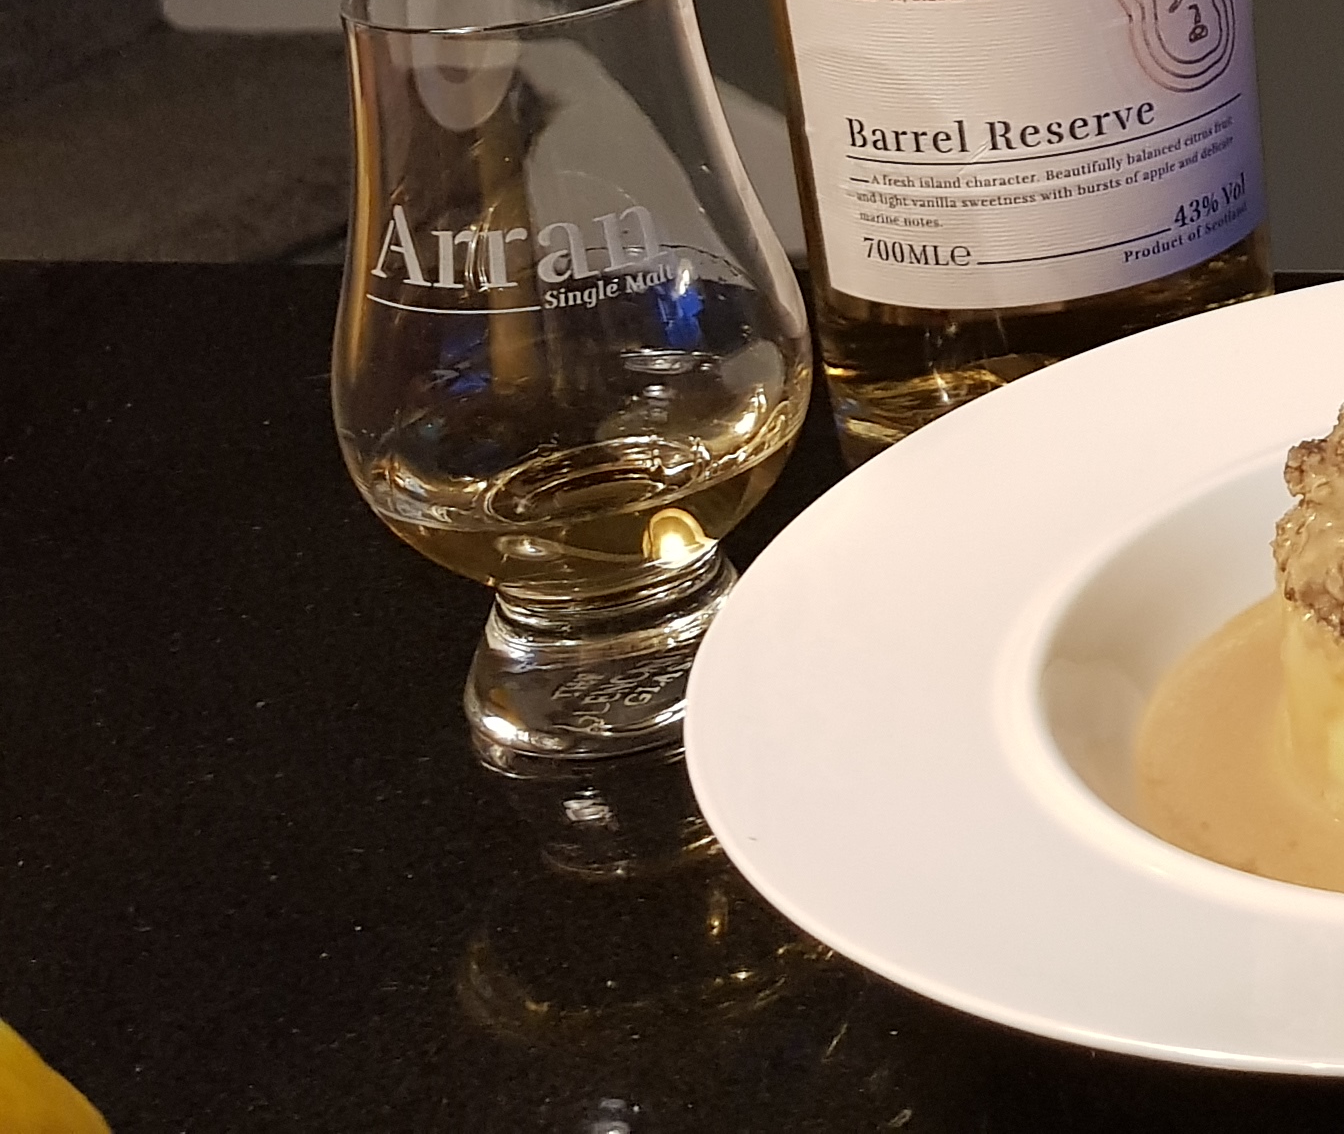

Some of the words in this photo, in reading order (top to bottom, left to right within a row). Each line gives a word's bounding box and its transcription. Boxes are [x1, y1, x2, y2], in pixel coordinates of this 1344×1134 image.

[846, 117, 970, 154] Barrel
[985, 101, 1155, 152] Reserve
[856, 192, 877, 204] and
[880, 193, 907, 209] light
[911, 196, 958, 209] vanilla
[961, 192, 1037, 208] sweetness
[1040, 185, 1073, 201] with
[1077, 177, 1122, 196] bursts
[1125, 171, 1140, 185] of
[1143, 161, 1176, 183] apple
[1178, 150, 1199, 170] and
[871, 174, 880, 185] A
[882, 174, 916, 188] fresh
[919, 176, 961, 189] island
[966, 173, 1040, 188] character.
[1046, 157, 1123, 181] Beautifully
[1127, 140, 1182, 166] balanced
[1184, 128, 1213, 147] citrus
[859, 210, 900, 225] marine
[903, 215, 944, 228] notes.
[1174, 191, 1219, 229] 43%
[1222, 171, 1246, 206] Vol
[370, 204, 668, 290] Arran
[1124, 235, 1184, 263] Product
[1188, 228, 1201, 243] of
[544, 278, 619, 311] Single
[625, 263, 674, 294] Malt
